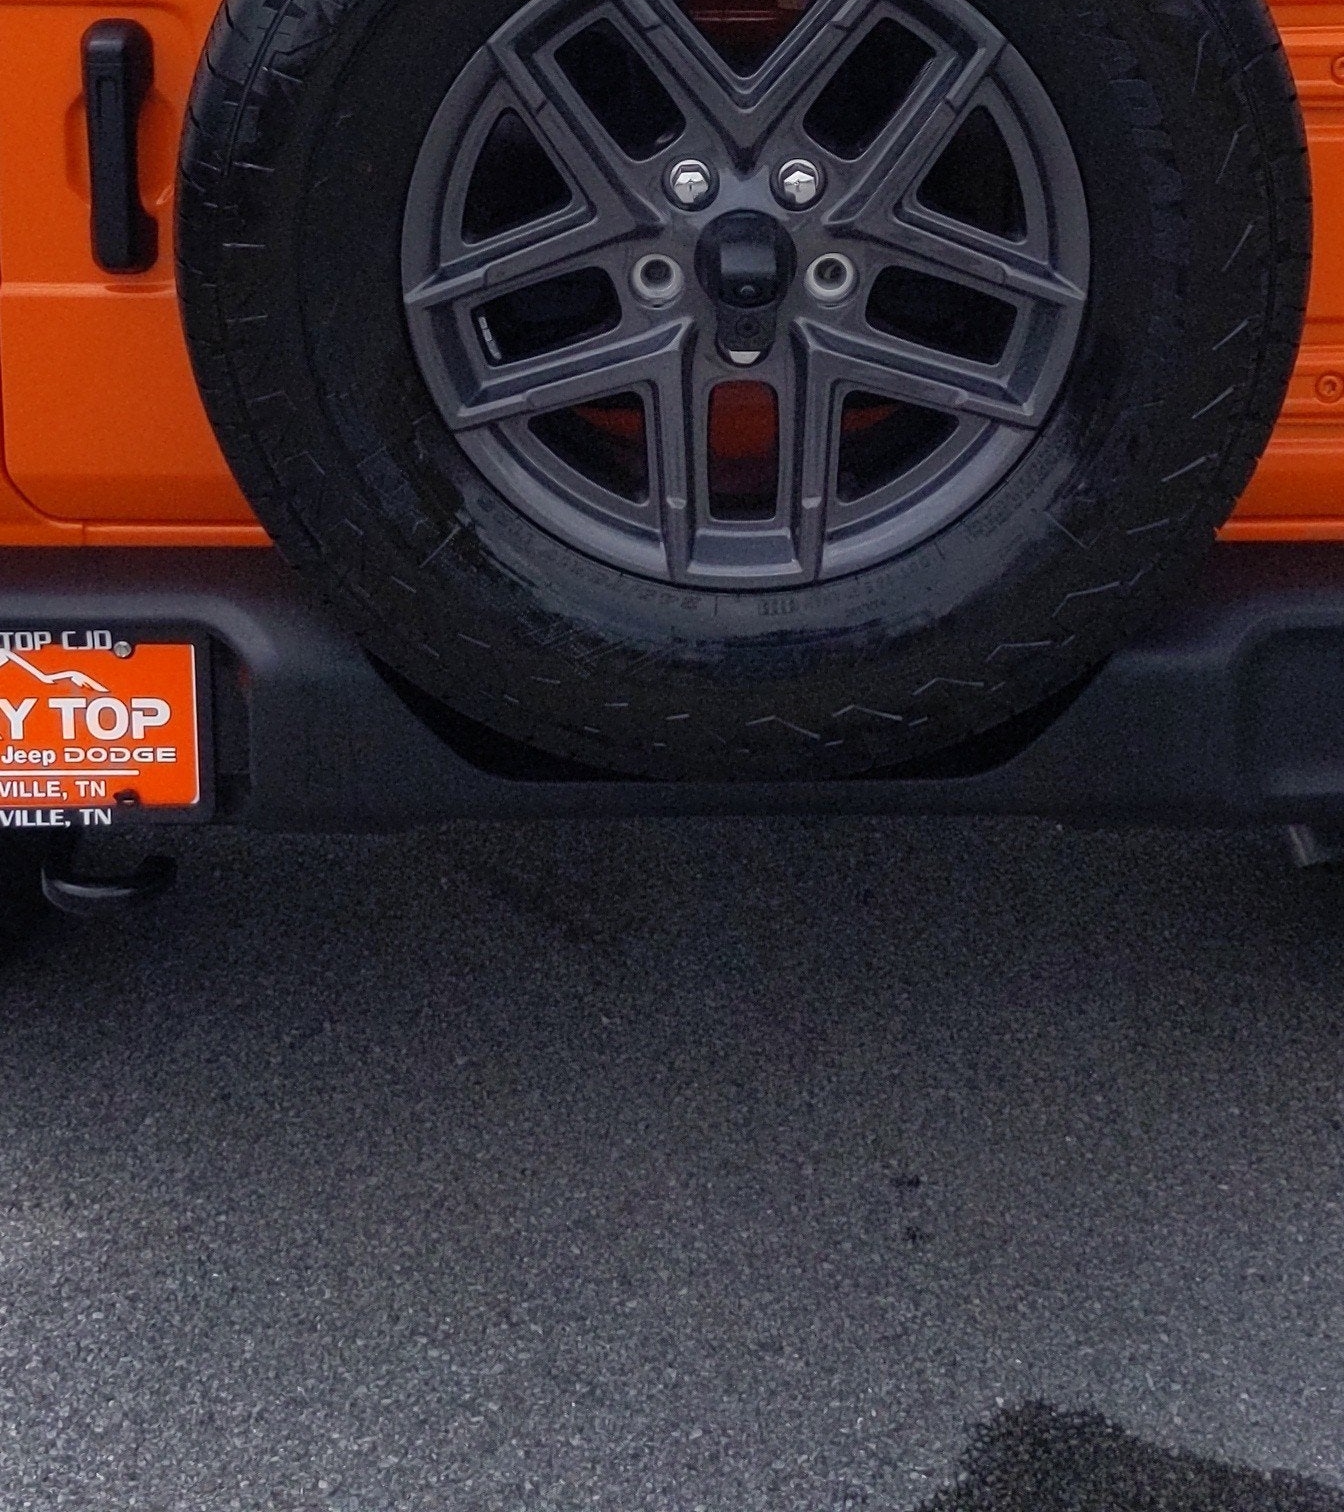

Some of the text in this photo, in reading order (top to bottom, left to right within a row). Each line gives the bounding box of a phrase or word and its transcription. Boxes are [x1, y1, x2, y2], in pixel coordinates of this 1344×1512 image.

[61, 629, 113, 651] CJD
[48, 696, 172, 741] TOP
[0, 745, 57, 767] Jeep
[64, 747, 178, 763] DODGE
[74, 780, 107, 798] TN
[78, 807, 112, 826] TN
